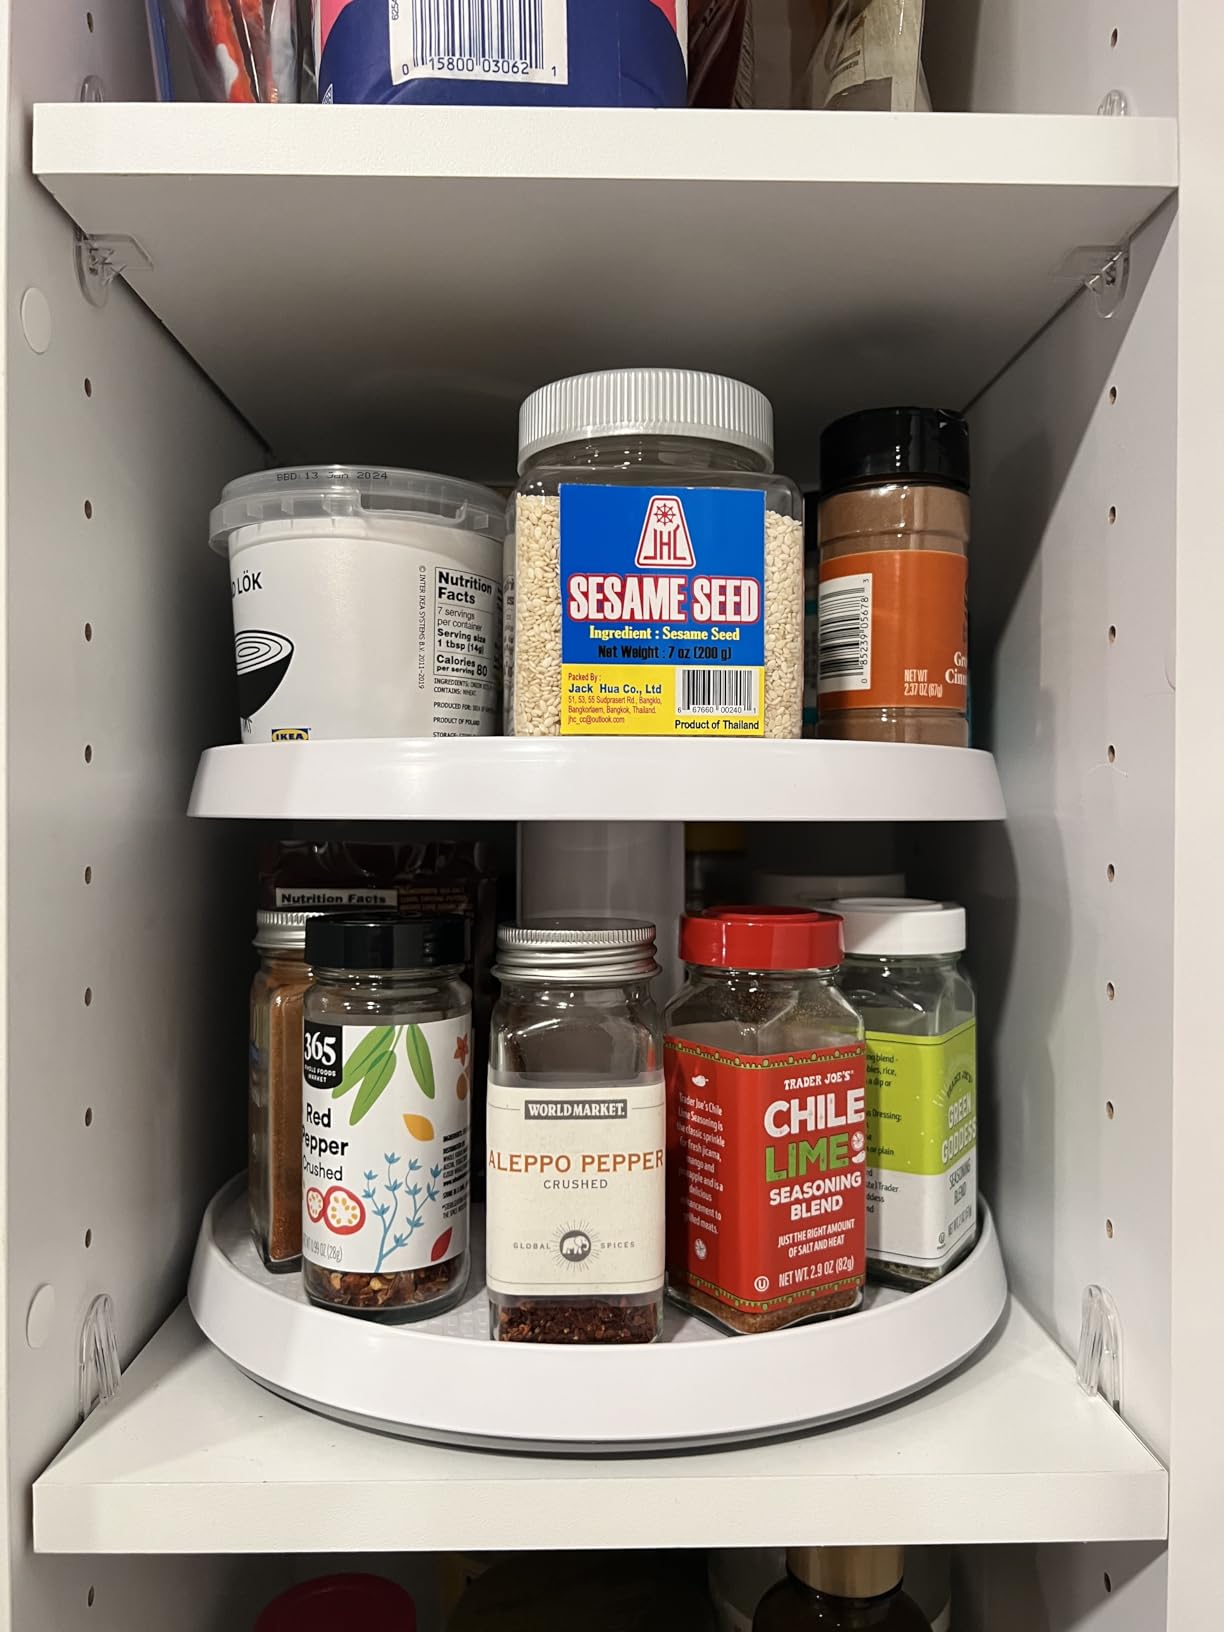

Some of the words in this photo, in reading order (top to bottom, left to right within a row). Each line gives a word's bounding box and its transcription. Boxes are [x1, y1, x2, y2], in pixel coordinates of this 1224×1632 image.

[402, 63, 409, 76] 0
[428, 57, 475, 72] 15800
[482, 59, 530, 75] 03062
[551, 66, 557, 77] 1
[276, 472, 304, 481] BBD
[304, 471, 319, 480] 13
[356, 471, 388, 480] 2024
[237, 570, 262, 595] LÖK
[438, 571, 492, 595] Nutrition
[438, 587, 476, 604] Facts
[569, 575, 687, 621] SESAME
[692, 576, 760, 623] SEED
[438, 606, 443, 615] 7
[445, 609, 475, 621] servings
[861, 597, 869, 629] 05678
[437, 618, 450, 627] per
[452, 621, 483, 632] container
[437, 628, 472, 642] Serving
[589, 626, 652, 640] Ingredient
[662, 626, 707, 640] Sesame
[711, 628, 740, 641] Seed
[446, 640, 466, 651] tbsp
[860, 633, 868, 666] 85239
[598, 646, 618, 658] Net
[621, 646, 659, 660] Weight
[668, 647, 674, 658] 7
[677, 649, 691, 659] oz
[693, 647, 718, 660] (200
[720, 648, 732, 660] g)
[437, 655, 476, 668] Calories
[477, 664, 488, 677] 80
[451, 667, 475, 676] serving
[568, 673, 589, 681] Packed
[590, 673, 598, 683] By
[904, 669, 917, 682] NET
[917, 669, 928, 682] WT
[568, 684, 593, 693] Jack
[599, 684, 620, 693] Hua
[623, 684, 642, 695] Co.,
[645, 684, 662, 694] Ltd
[904, 683, 918, 696] 2.37
[919, 683, 928, 696] OZ
[433, 702, 462, 710] PRODUCED
[675, 720, 709, 729] Product
[711, 720, 720, 729] of
[723, 720, 759, 730] Thailand
[281, 894, 343, 904] Nutrition
[348, 894, 387, 904] Facts
[304, 1032, 337, 1066] 365
[317, 1068, 336, 1077] FOODS
[883, 1066, 897, 1077] rice,
[784, 1076, 822, 1090] TRADER
[306, 1103, 331, 1128] Red
[708, 1102, 722, 1116] Chile
[764, 1087, 865, 1138] CHILE
[690, 1111, 717, 1132] Seasoning
[702, 1133, 725, 1147] sprinkle
[489, 1150, 571, 1173] ALEPPO
[582, 1149, 664, 1173] PEPPER
[765, 1133, 849, 1183] LIME
[543, 1179, 608, 1189] CRUSHED
[769, 1171, 862, 1206] SEASONING
[878, 1182, 899, 1193] Trader
[790, 1195, 843, 1221] BLEND
[778, 1234, 794, 1249] JUST
[793, 1231, 807, 1245] THE
[807, 1227, 827, 1242] RIGHT
[826, 1219, 855, 1237] AMOUNT
[513, 1242, 550, 1250] GLOBAL
[600, 1241, 635, 1249] SPICES
[788, 1247, 798, 1258] OF
[798, 1243, 814, 1257] SALT
[813, 1239, 828, 1253] AND
[828, 1234, 845, 1250] HEAT
[779, 1272, 794, 1288] NET
[795, 1268, 810, 1284] WT.
[810, 1265, 823, 1280] 2.9
[824, 1262, 834, 1277] OZ
[836, 1255, 854, 1273] (82g)
